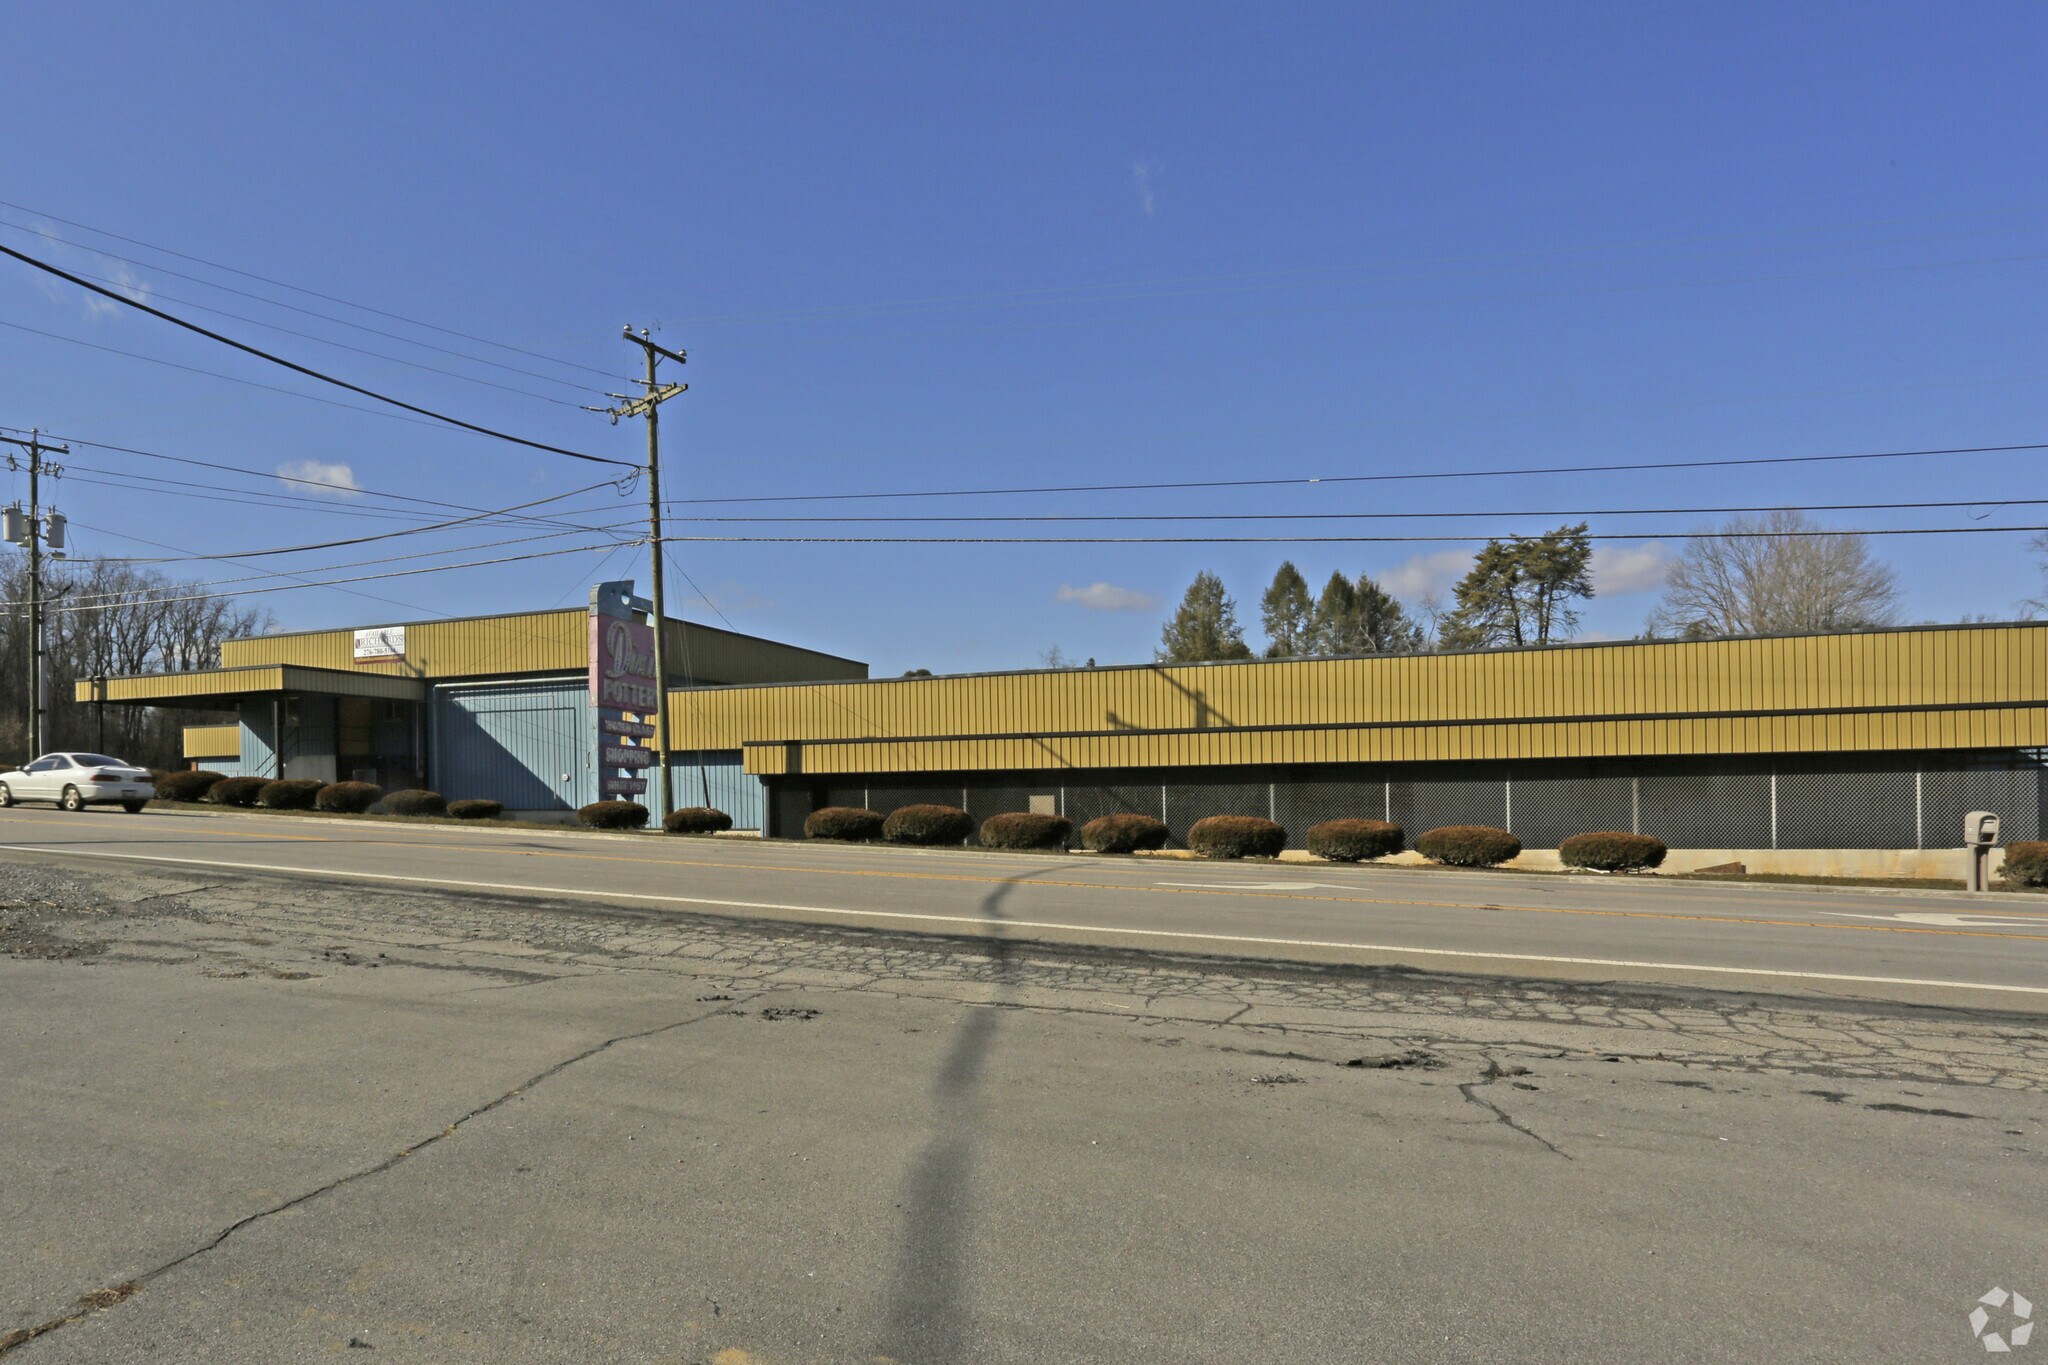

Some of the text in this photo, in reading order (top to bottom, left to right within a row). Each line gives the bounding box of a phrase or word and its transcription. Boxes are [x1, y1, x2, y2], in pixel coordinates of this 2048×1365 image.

[605, 620, 658, 678] Dixi
[603, 678, 658, 709] POTTER
[605, 747, 651, 765] SHOPPING
